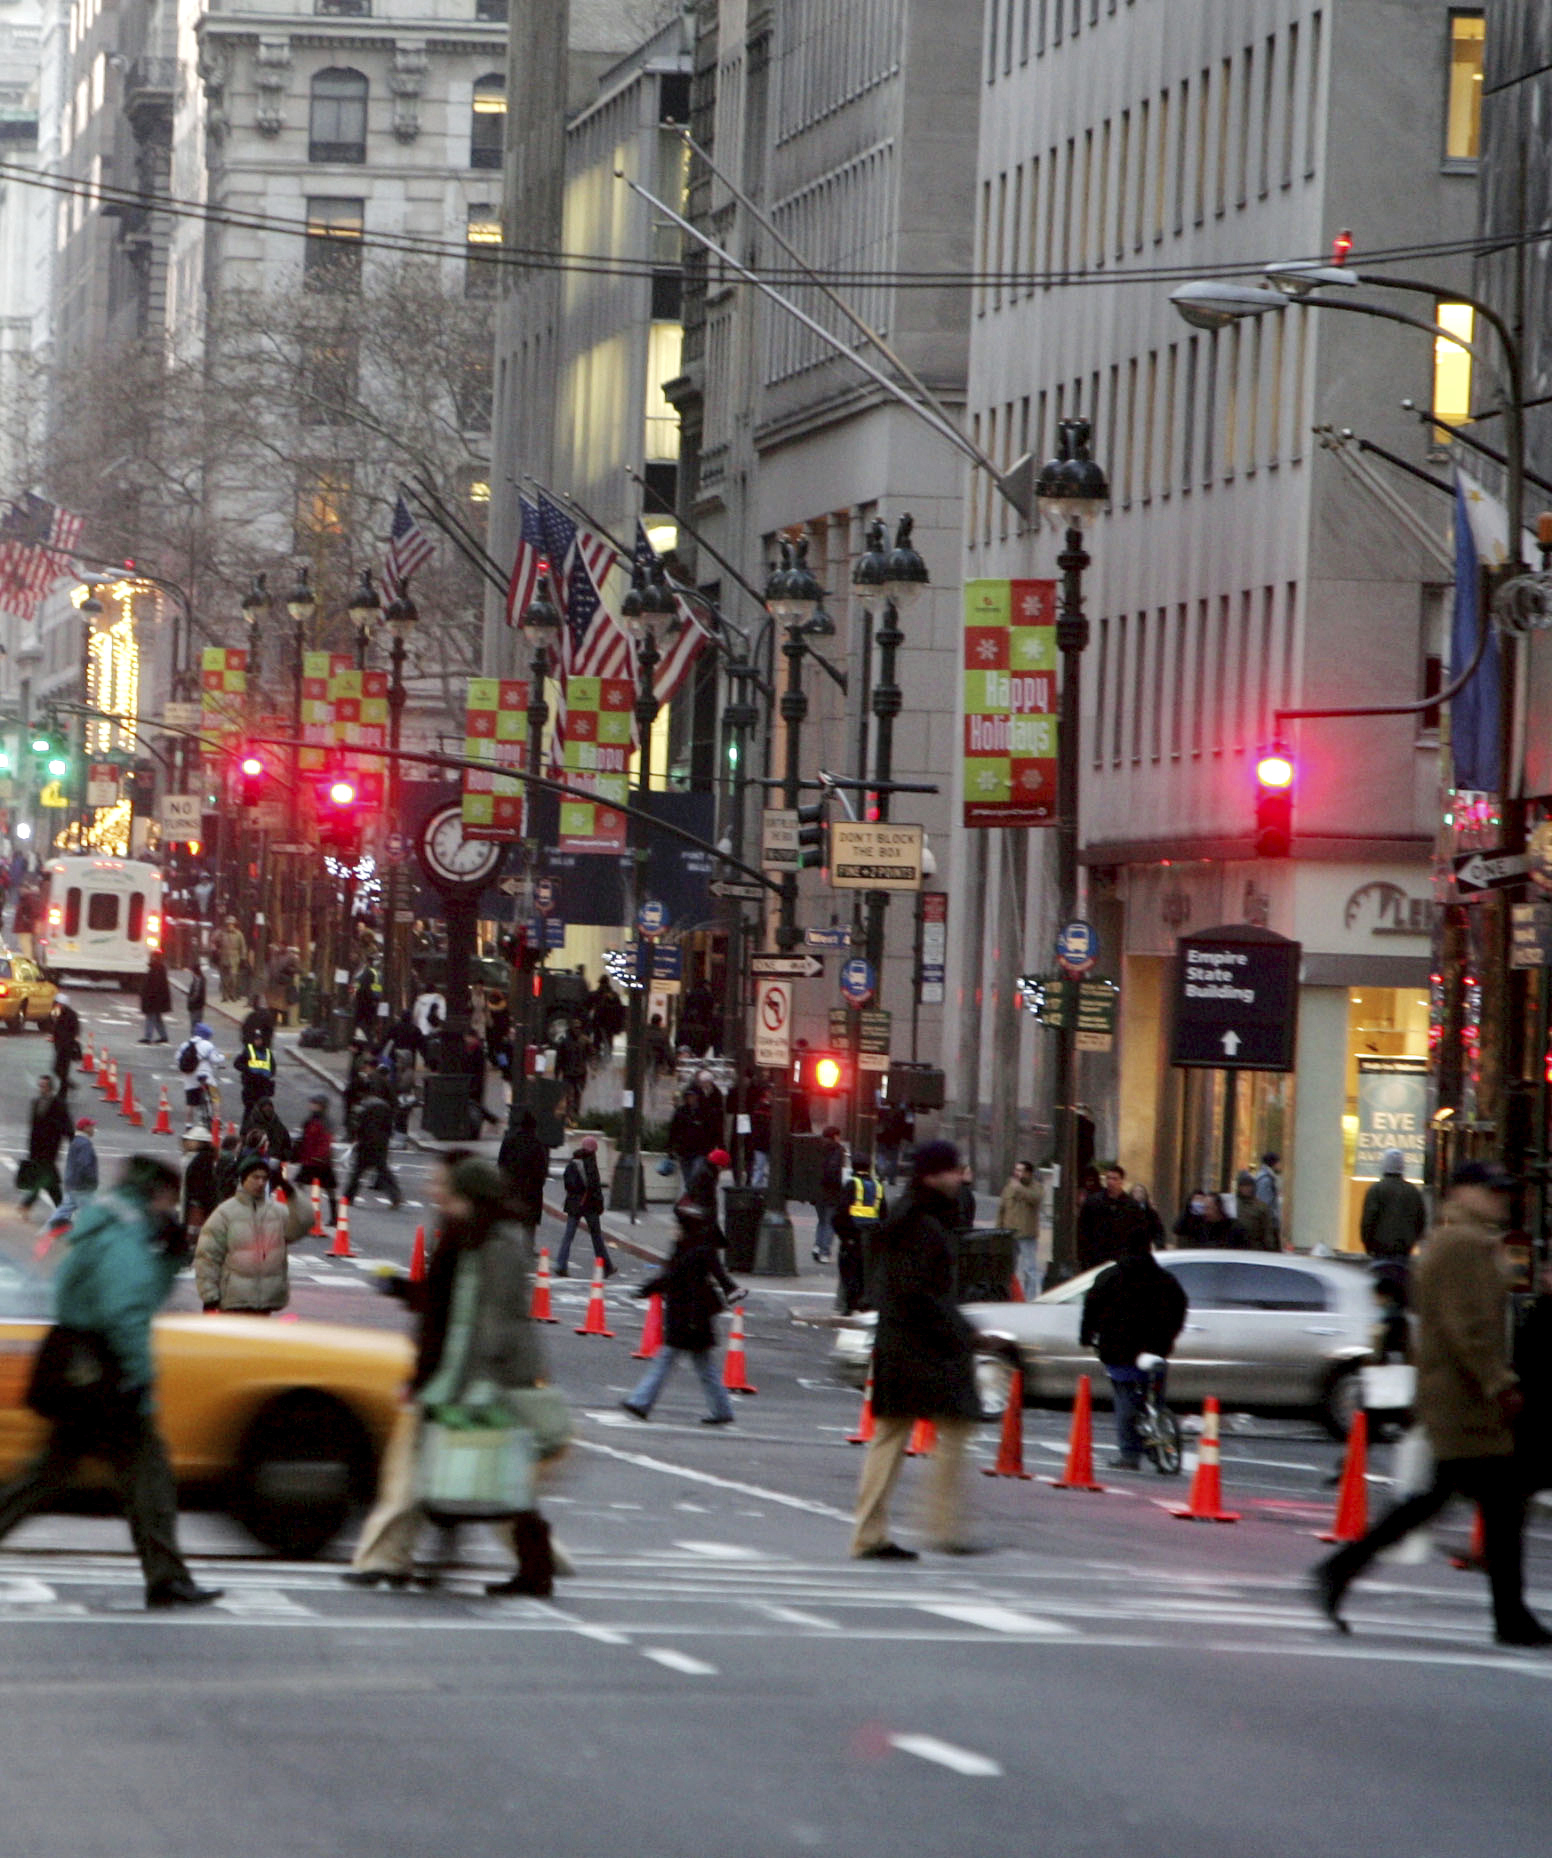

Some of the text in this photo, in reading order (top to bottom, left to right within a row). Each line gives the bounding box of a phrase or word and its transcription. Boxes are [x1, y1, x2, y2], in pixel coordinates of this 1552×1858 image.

[985, 670, 1049, 714] Happy
[970, 714, 1050, 758] Holidays
[170, 801, 193, 815] NO
[1471, 859, 1508, 880] ONE
[1186, 950, 1248, 967] Empire
[1186, 967, 1234, 982] State
[1184, 983, 1255, 1004] Building
[1372, 1111, 1416, 1131] EYE
[1359, 1132, 1425, 1150] EXAMS
